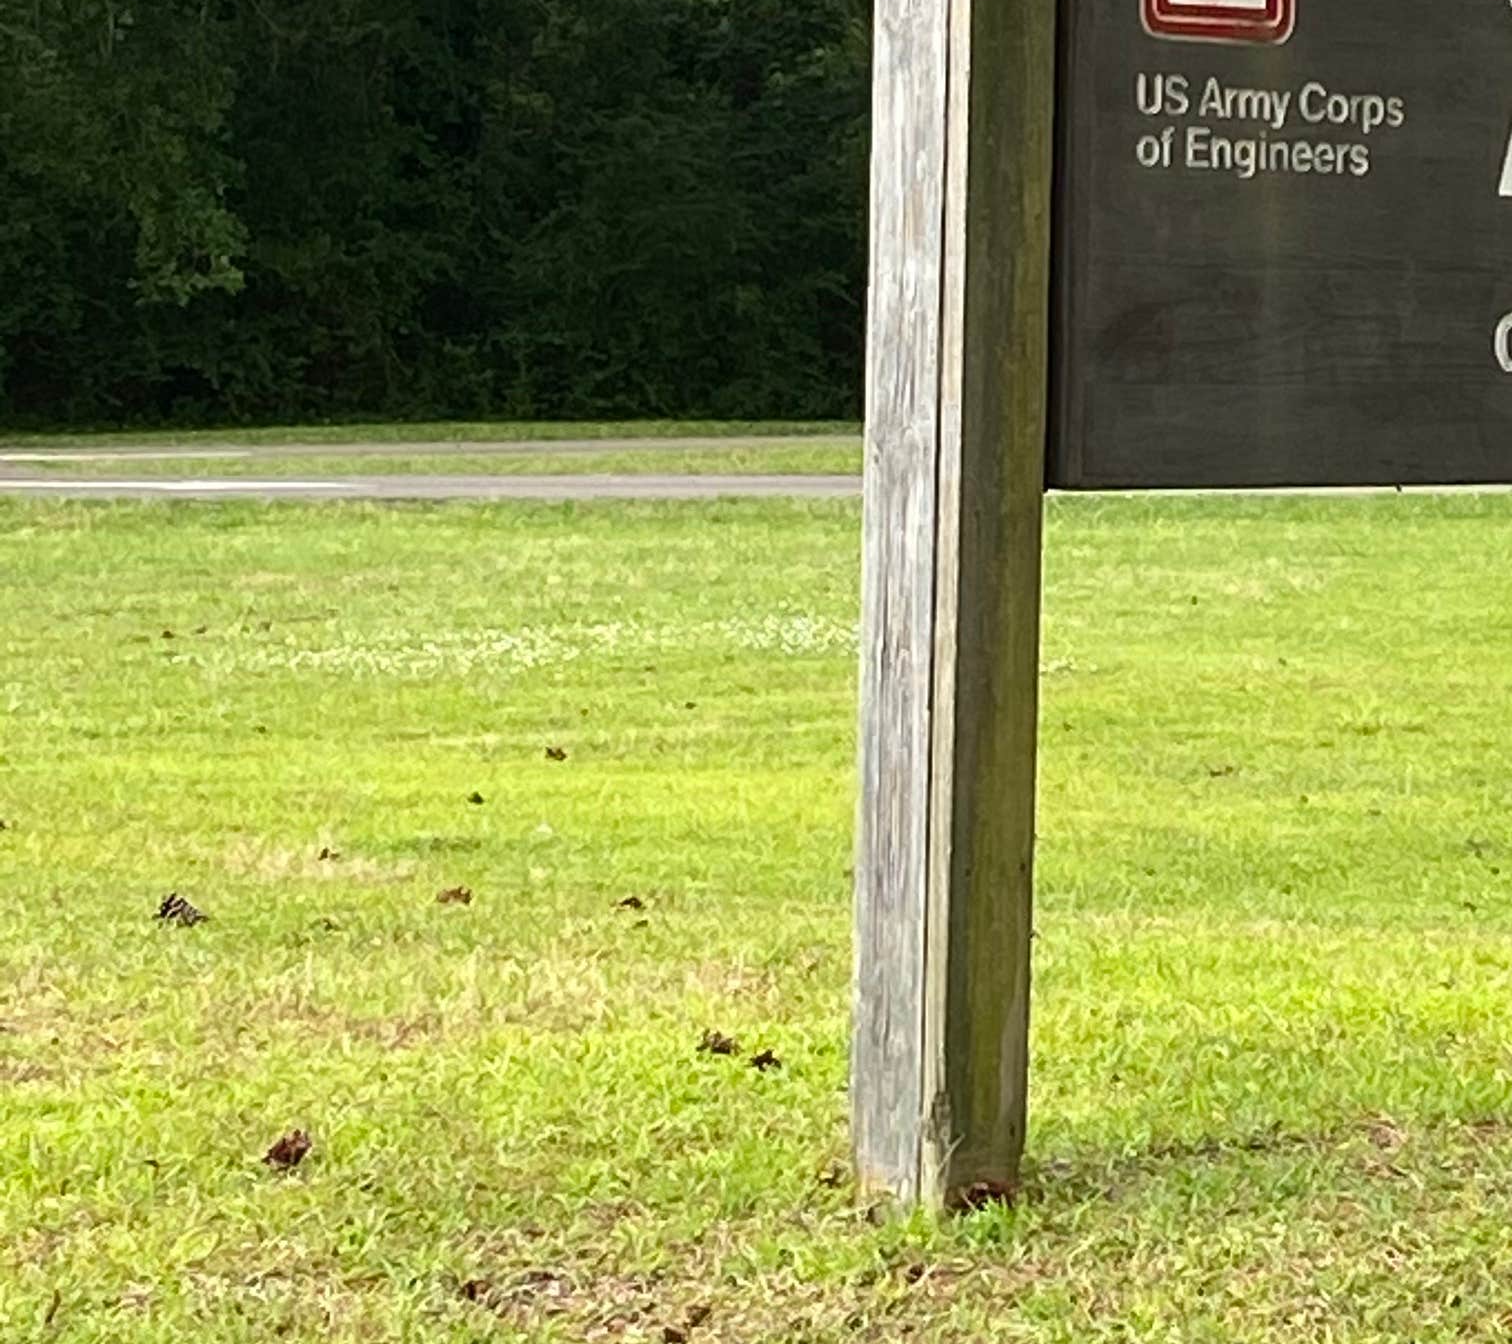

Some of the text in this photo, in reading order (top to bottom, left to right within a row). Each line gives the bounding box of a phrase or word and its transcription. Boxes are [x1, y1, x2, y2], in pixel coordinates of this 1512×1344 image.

[1135, 72, 1405, 135] US Army Corps
[1135, 125, 1371, 180] of Engineers
